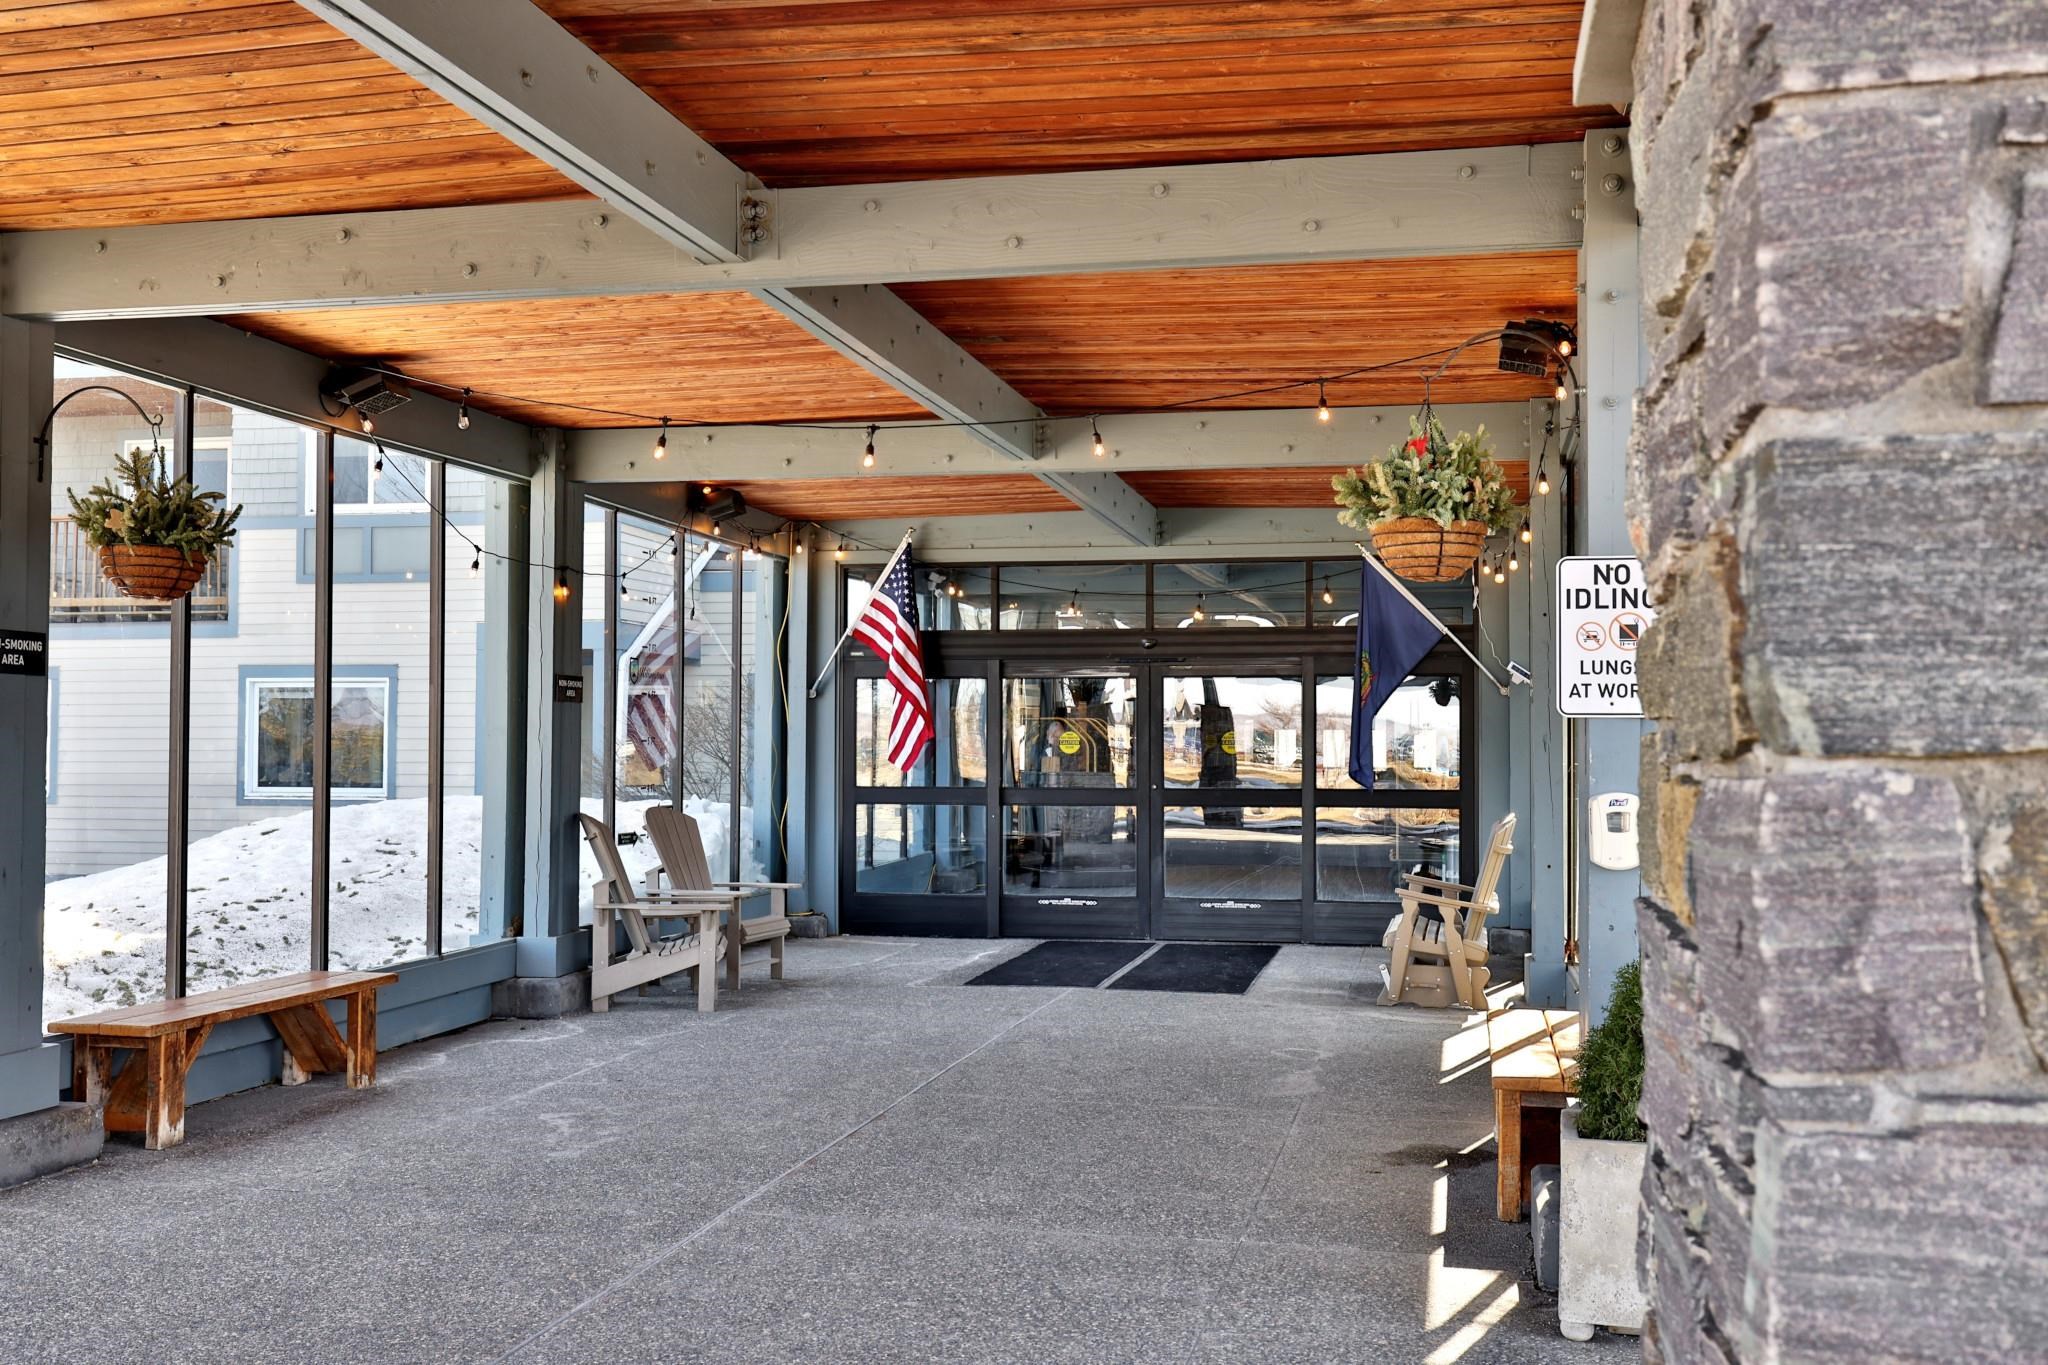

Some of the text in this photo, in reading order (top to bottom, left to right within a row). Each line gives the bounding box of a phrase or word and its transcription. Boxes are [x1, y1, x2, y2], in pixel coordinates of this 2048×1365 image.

[1593, 563, 1631, 586] NO
[1, 653, 25, 666] AREA
[1580, 659, 1637, 676] LUNG
[1568, 682, 1639, 699] AT WOR
